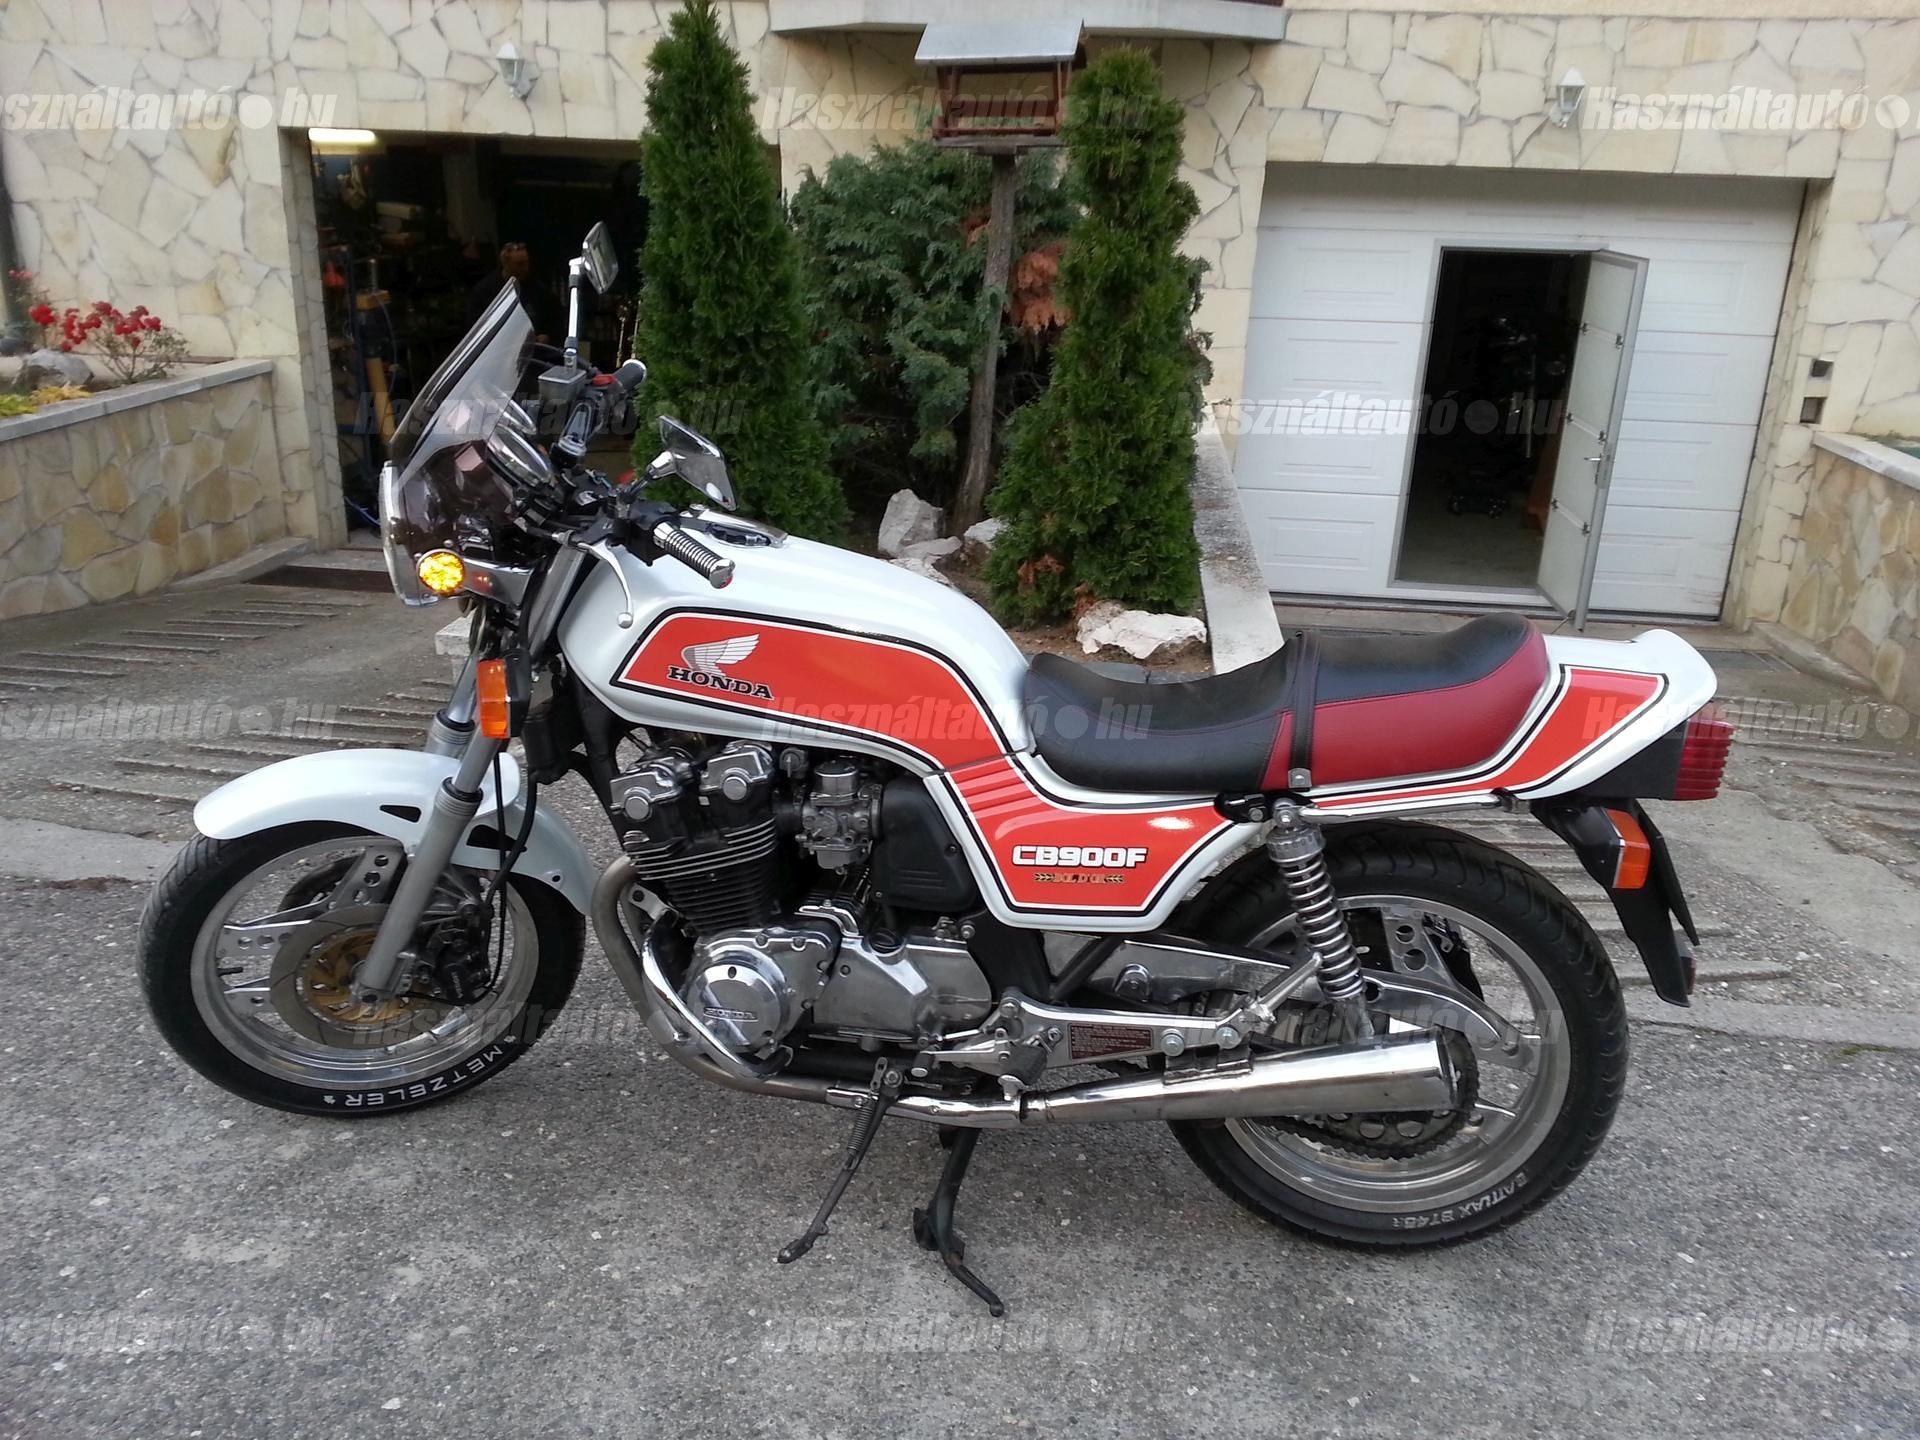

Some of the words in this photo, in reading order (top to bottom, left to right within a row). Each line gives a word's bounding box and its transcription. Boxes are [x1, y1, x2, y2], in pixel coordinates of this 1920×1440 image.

[668, 666, 774, 700] HONDA
[1012, 845, 1149, 868] CB900F
[344, 1045, 503, 1106] METZELER
